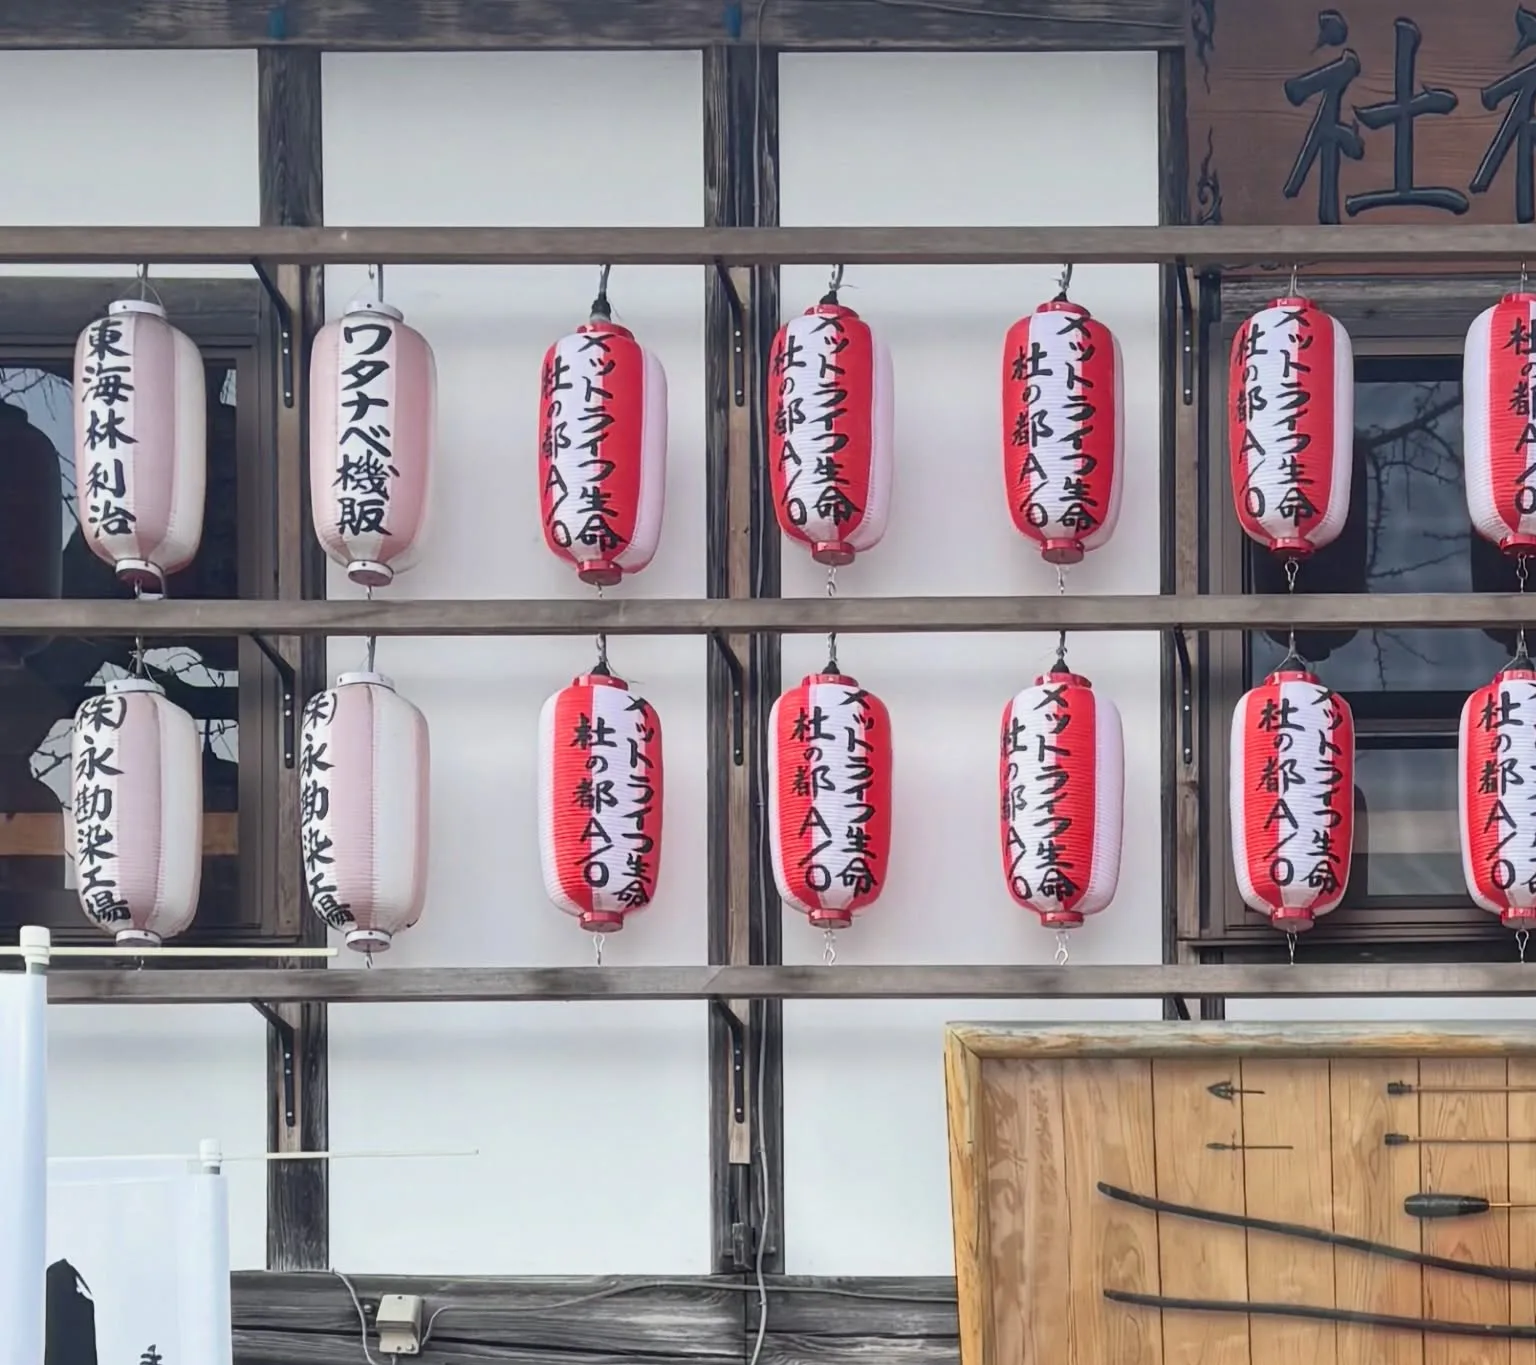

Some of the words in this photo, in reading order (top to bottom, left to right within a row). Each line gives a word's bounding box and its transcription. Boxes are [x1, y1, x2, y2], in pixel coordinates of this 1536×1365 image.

[82, 320, 139, 538] 東海林利治
[331, 324, 400, 536] ワタナベ機販
